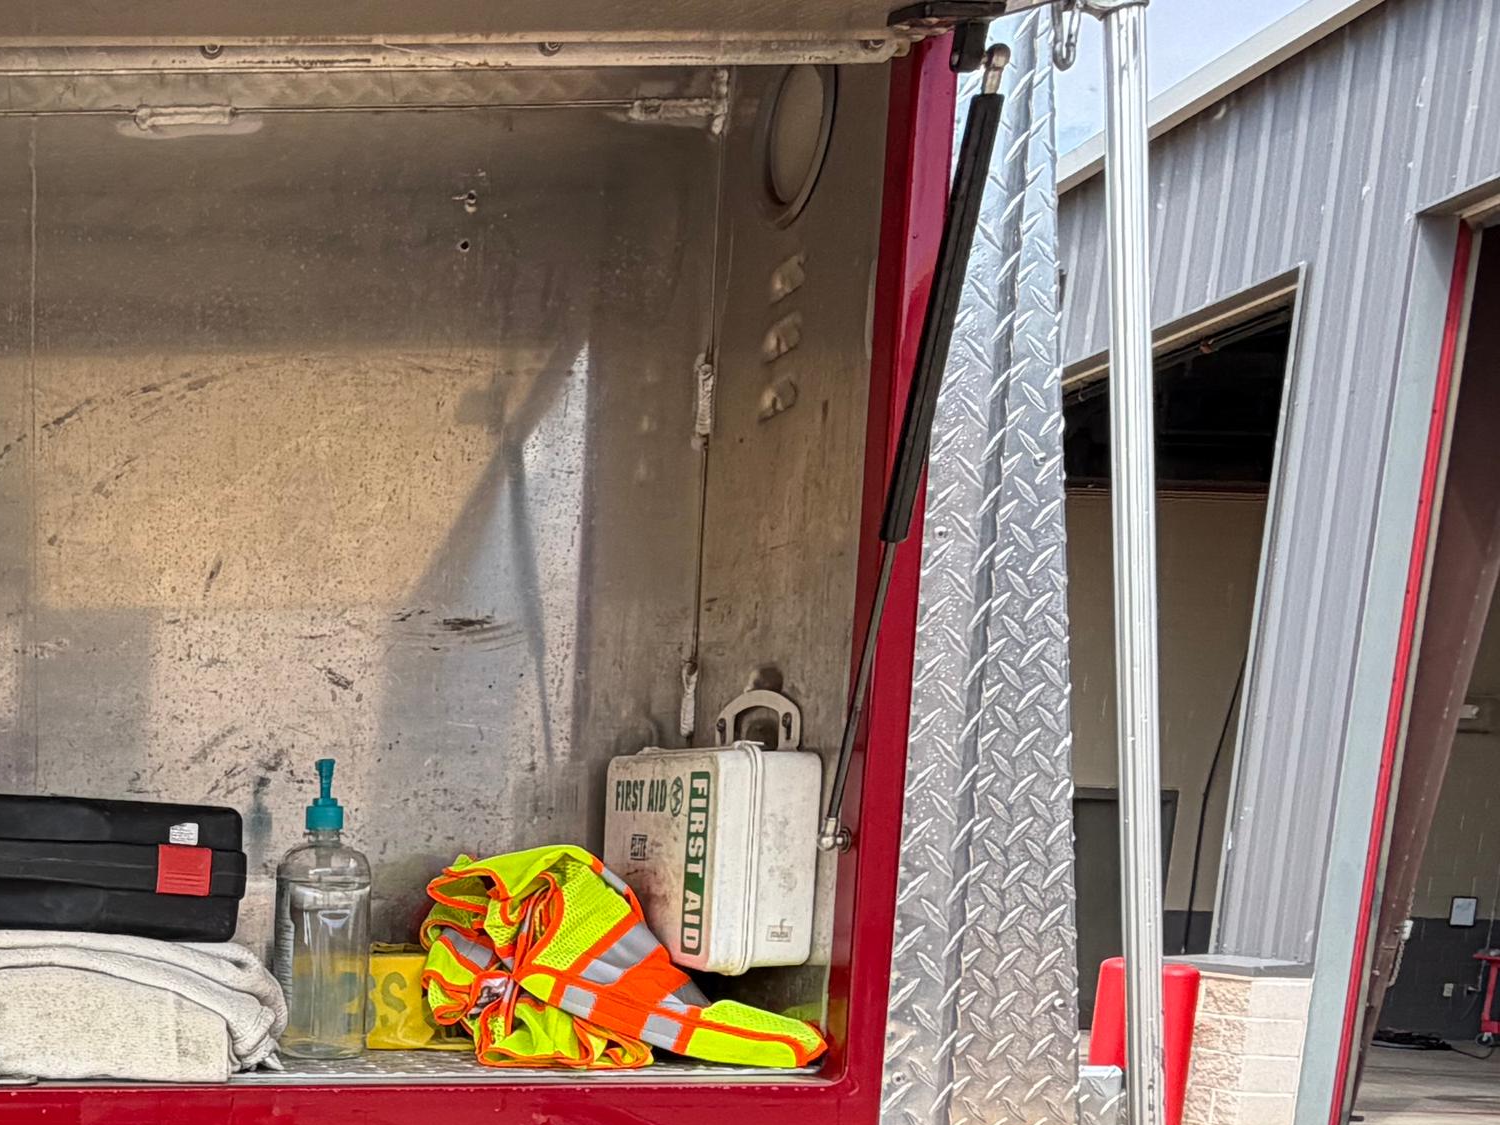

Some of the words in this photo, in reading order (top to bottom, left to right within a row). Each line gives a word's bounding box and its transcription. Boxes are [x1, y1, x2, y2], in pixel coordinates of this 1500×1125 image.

[615, 780, 645, 812] FIRST
[647, 779, 667, 812] AID
[687, 779, 709, 878] FIRST
[684, 890, 701, 949] AID
